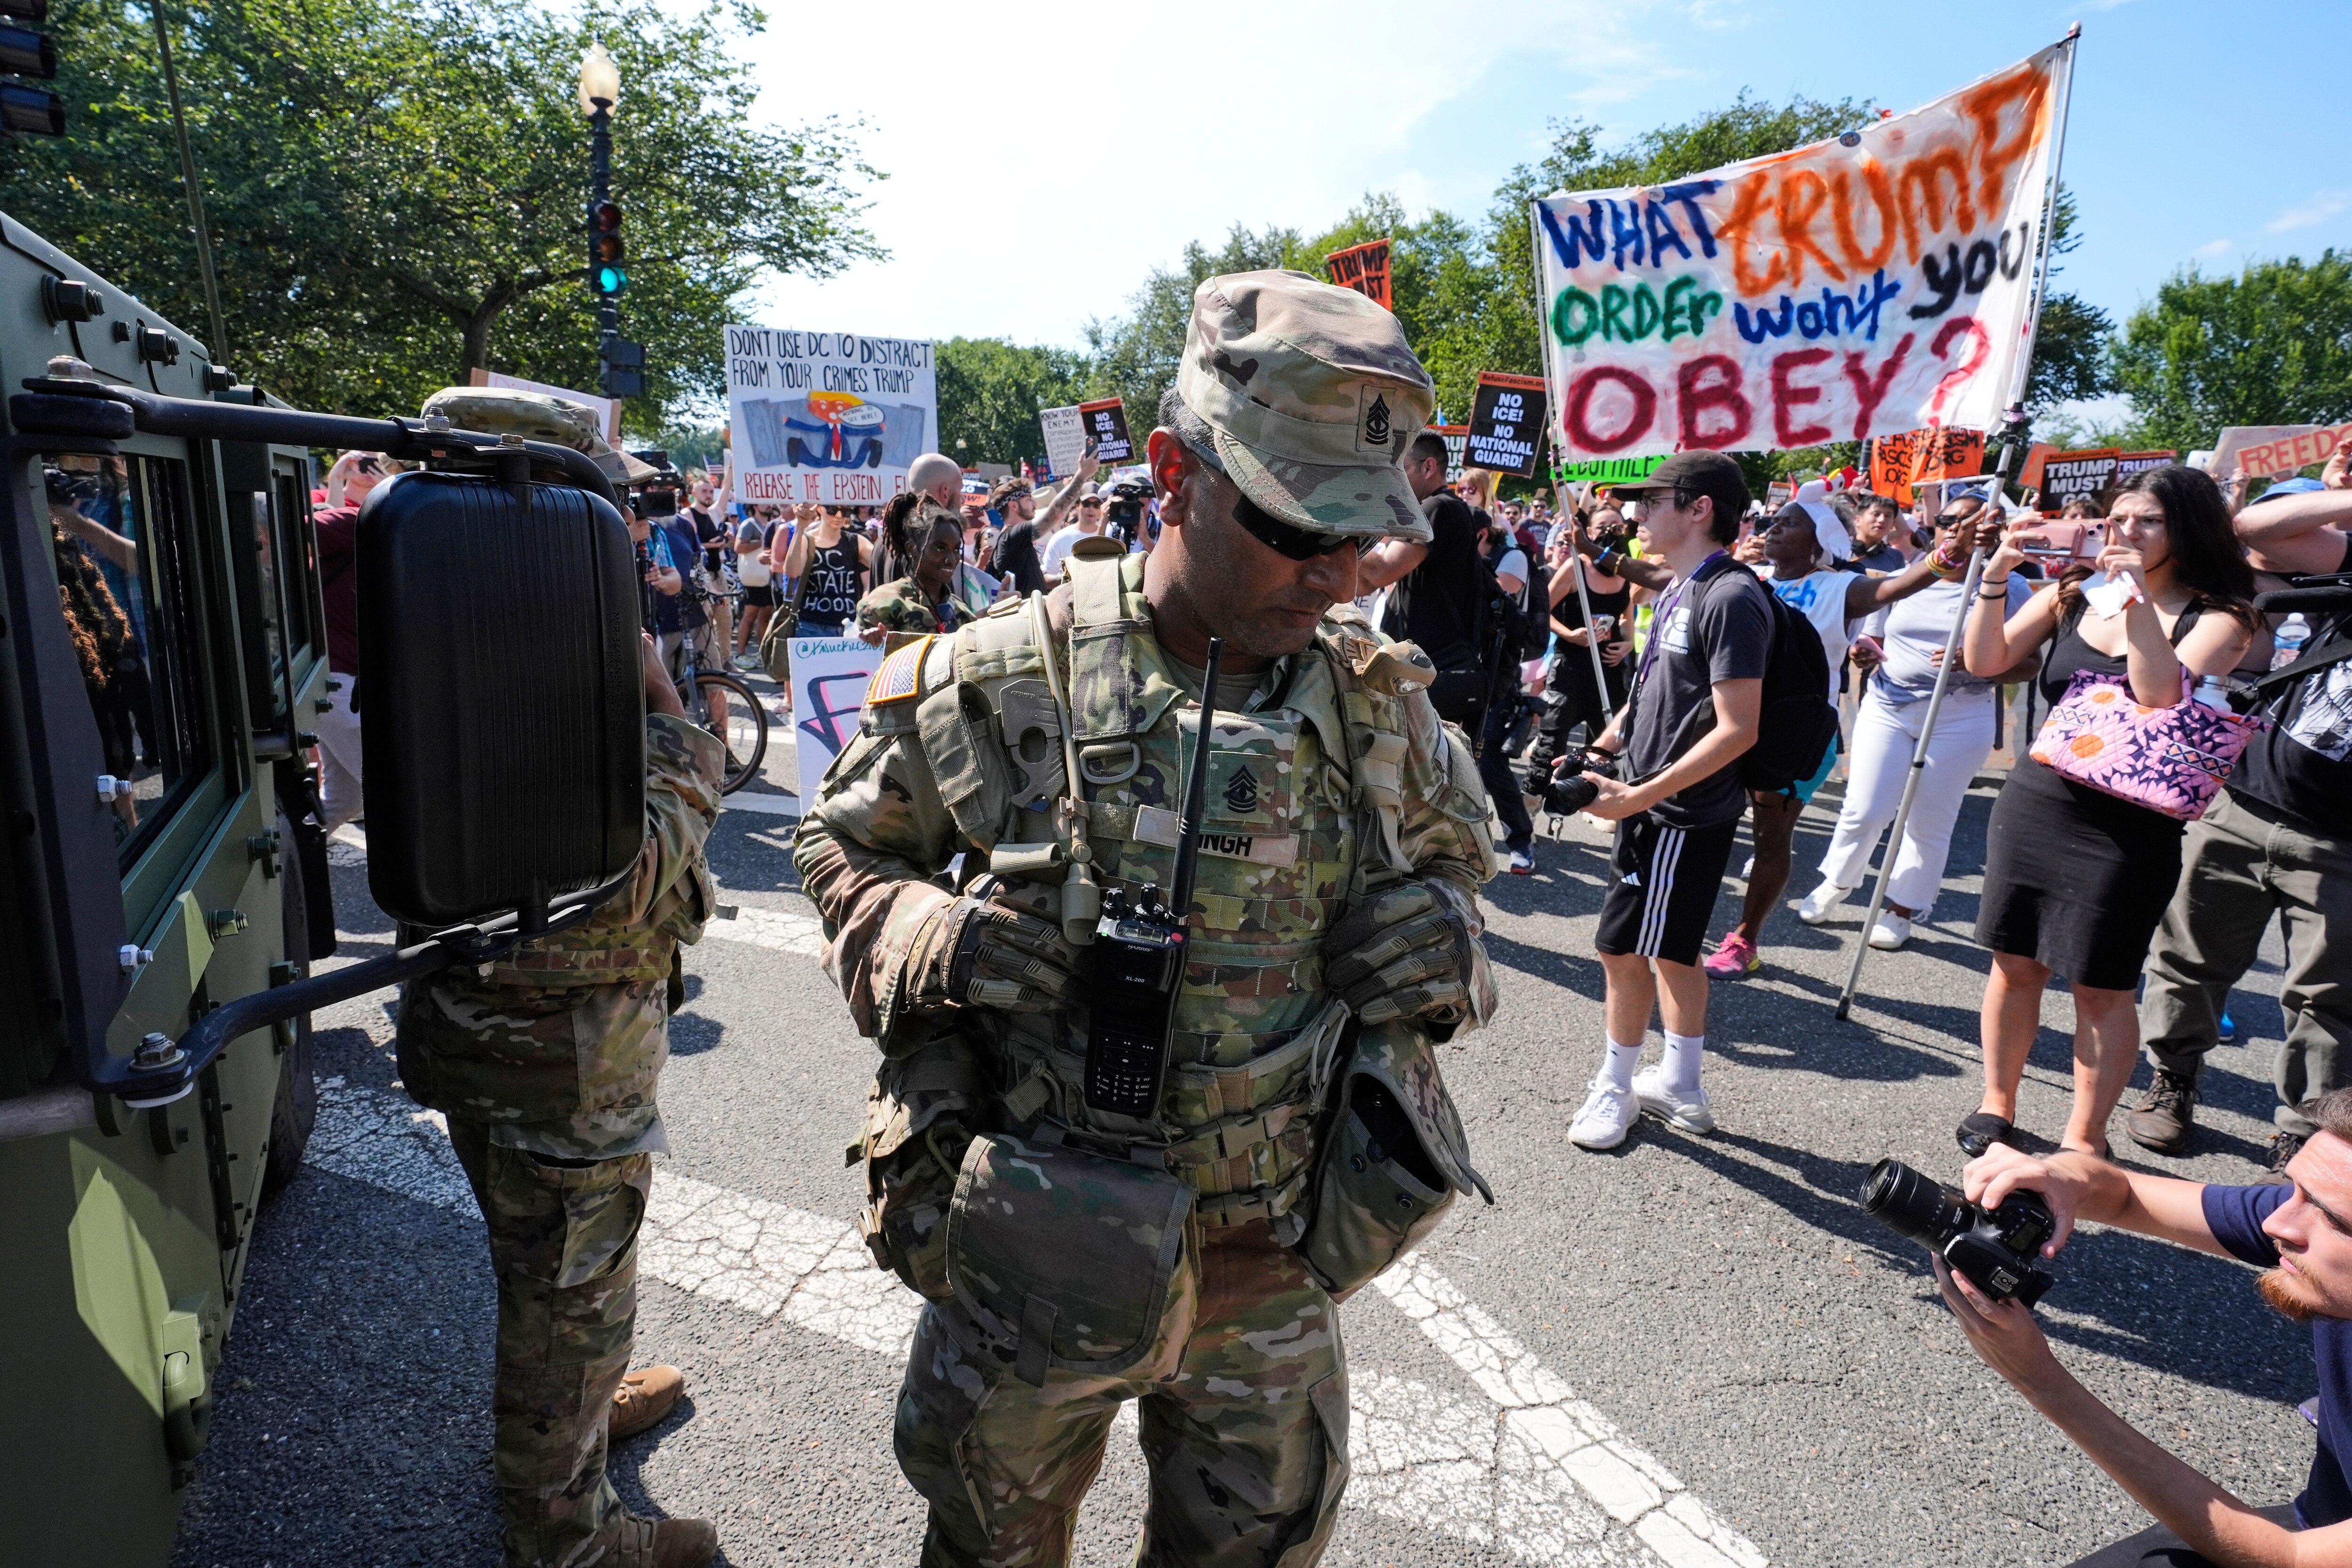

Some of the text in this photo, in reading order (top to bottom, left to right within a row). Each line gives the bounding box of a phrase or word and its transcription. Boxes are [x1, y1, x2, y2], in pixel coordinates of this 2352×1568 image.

[1537, 180, 1722, 270] WHAT
[1329, 245, 1389, 283] TRUMP
[730, 330, 930, 368] DON'T USE DC TO DISTRACT
[733, 358, 770, 388] FROM
[777, 361, 812, 389] YOUR
[874, 368, 914, 394] TRUMP
[1498, 393, 1523, 407] NO
[1095, 412, 1110, 422] NO
[1492, 406, 1524, 422] ICE!
[1048, 418, 1074, 429] ENEMY
[1095, 421, 1114, 431] ICE!
[1494, 424, 1514, 438] NO
[1097, 439, 1130, 451] ATIONAL
[1101, 432, 1114, 442] NO
[1470, 435, 1534, 456] NATIONAL
[1098, 448, 1128, 460] GUARD!
[1474, 449, 1524, 468] GUARD!
[2046, 459, 2116, 478] TRUMP
[745, 473, 794, 499] RELEASE
[803, 474, 819, 500] THE
[834, 474, 881, 500] EPSTEIN
[2050, 475, 2107, 493] MUST
[806, 570, 855, 595] STATE
[803, 596, 856, 614] HOOD
[1198, 834, 1253, 856] INGH
